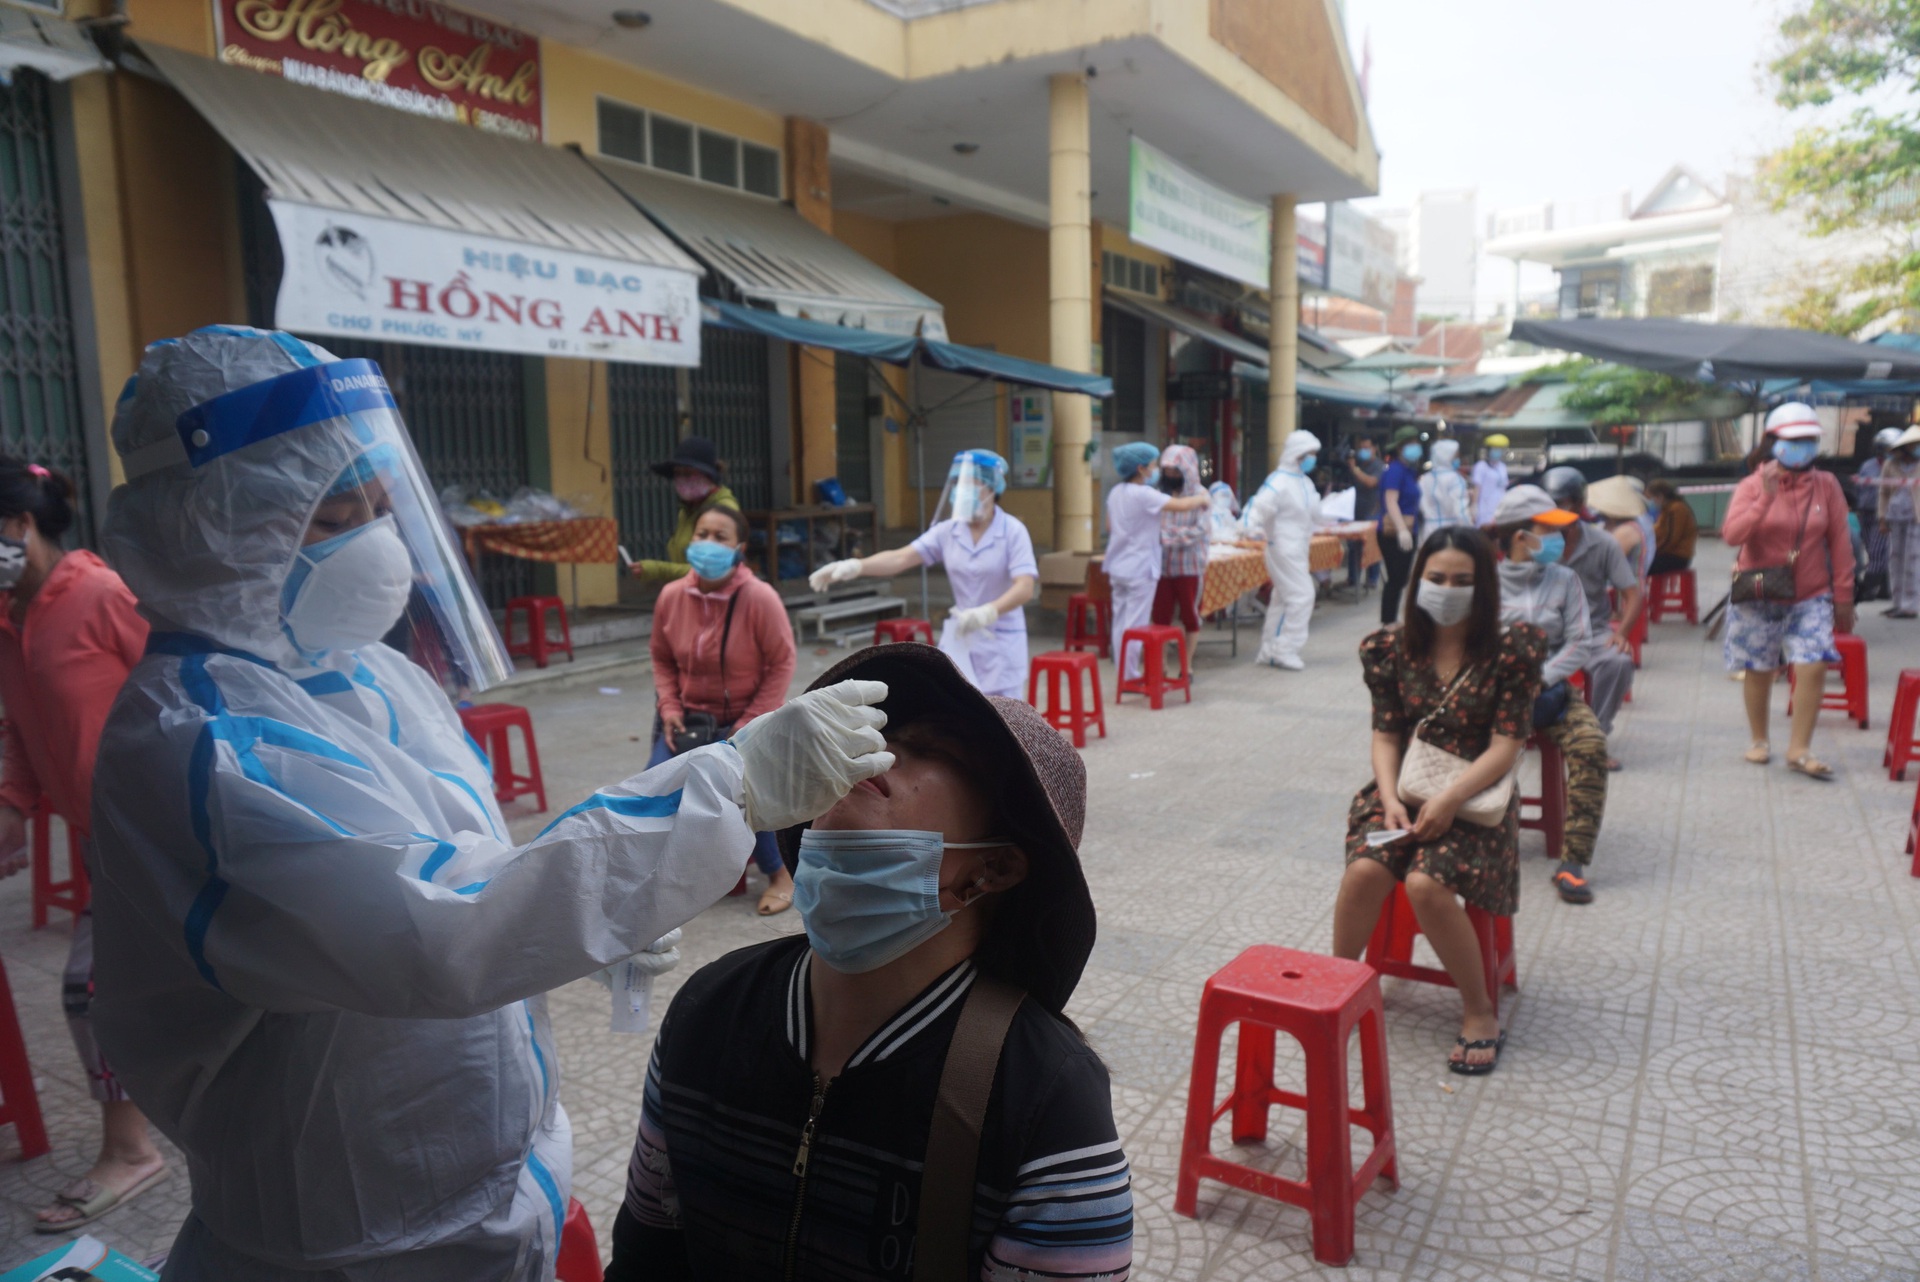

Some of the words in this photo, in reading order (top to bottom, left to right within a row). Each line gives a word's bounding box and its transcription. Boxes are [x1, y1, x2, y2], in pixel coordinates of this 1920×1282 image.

[418, 44, 538, 107] Anh
[462, 246, 559, 281] HIỆU
[574, 266, 643, 294] BẠC
[383, 270, 564, 330] HỒNG
[580, 307, 683, 344] ANH
